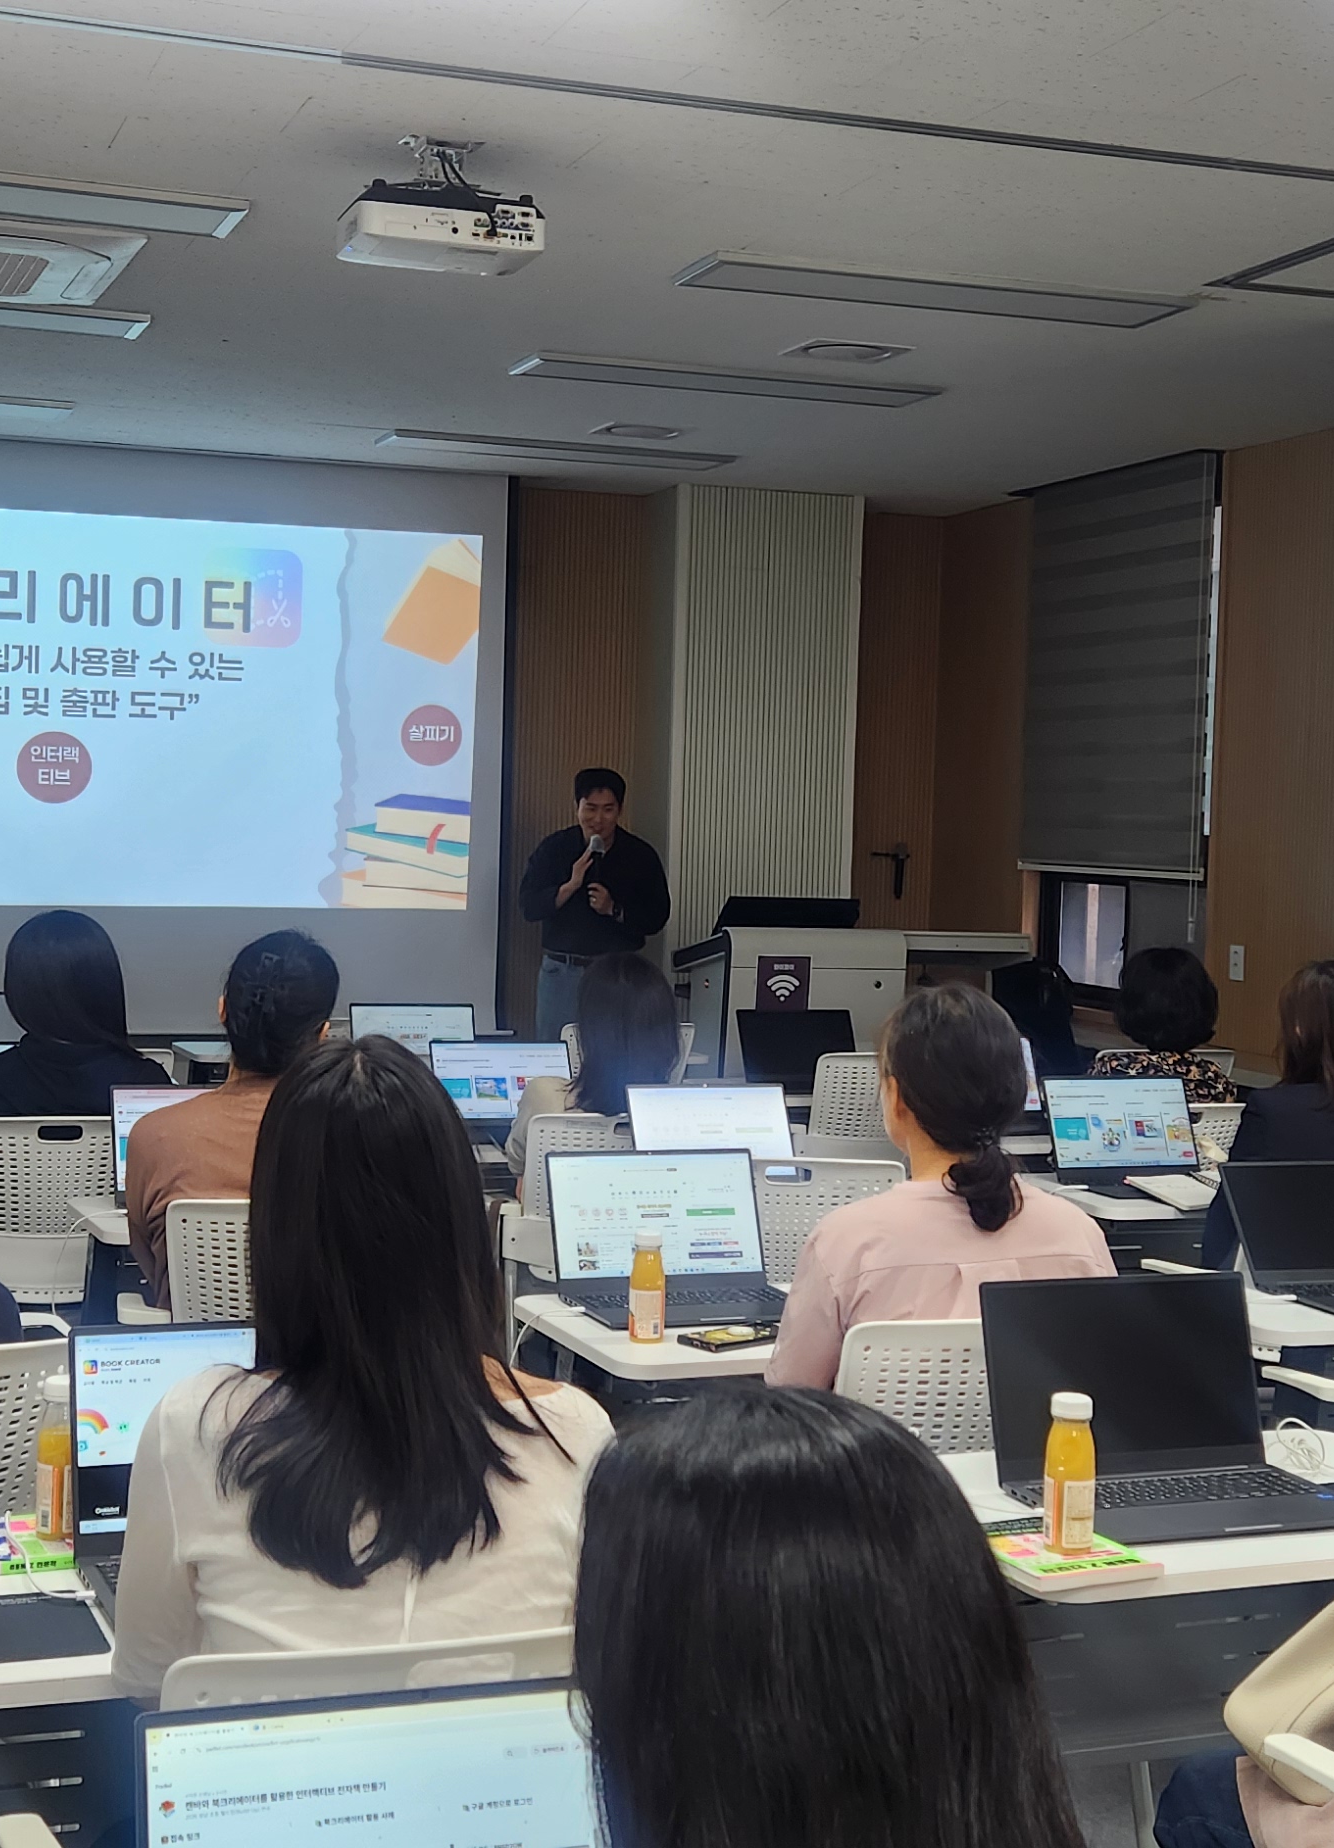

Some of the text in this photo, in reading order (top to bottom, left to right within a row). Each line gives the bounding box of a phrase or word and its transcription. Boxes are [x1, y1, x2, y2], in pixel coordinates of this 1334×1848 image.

[49, 646, 140, 678] 사용할
[148, 651, 178, 679] 수
[188, 651, 245, 682] 있는
[22, 687, 49, 716] 및
[60, 687, 119, 719] 출판
[408, 724, 454, 742] 살피기
[30, 745, 80, 763] 인터랙
[38, 768, 71, 786] 티브
[125, 1358, 161, 1366] CREATOR
